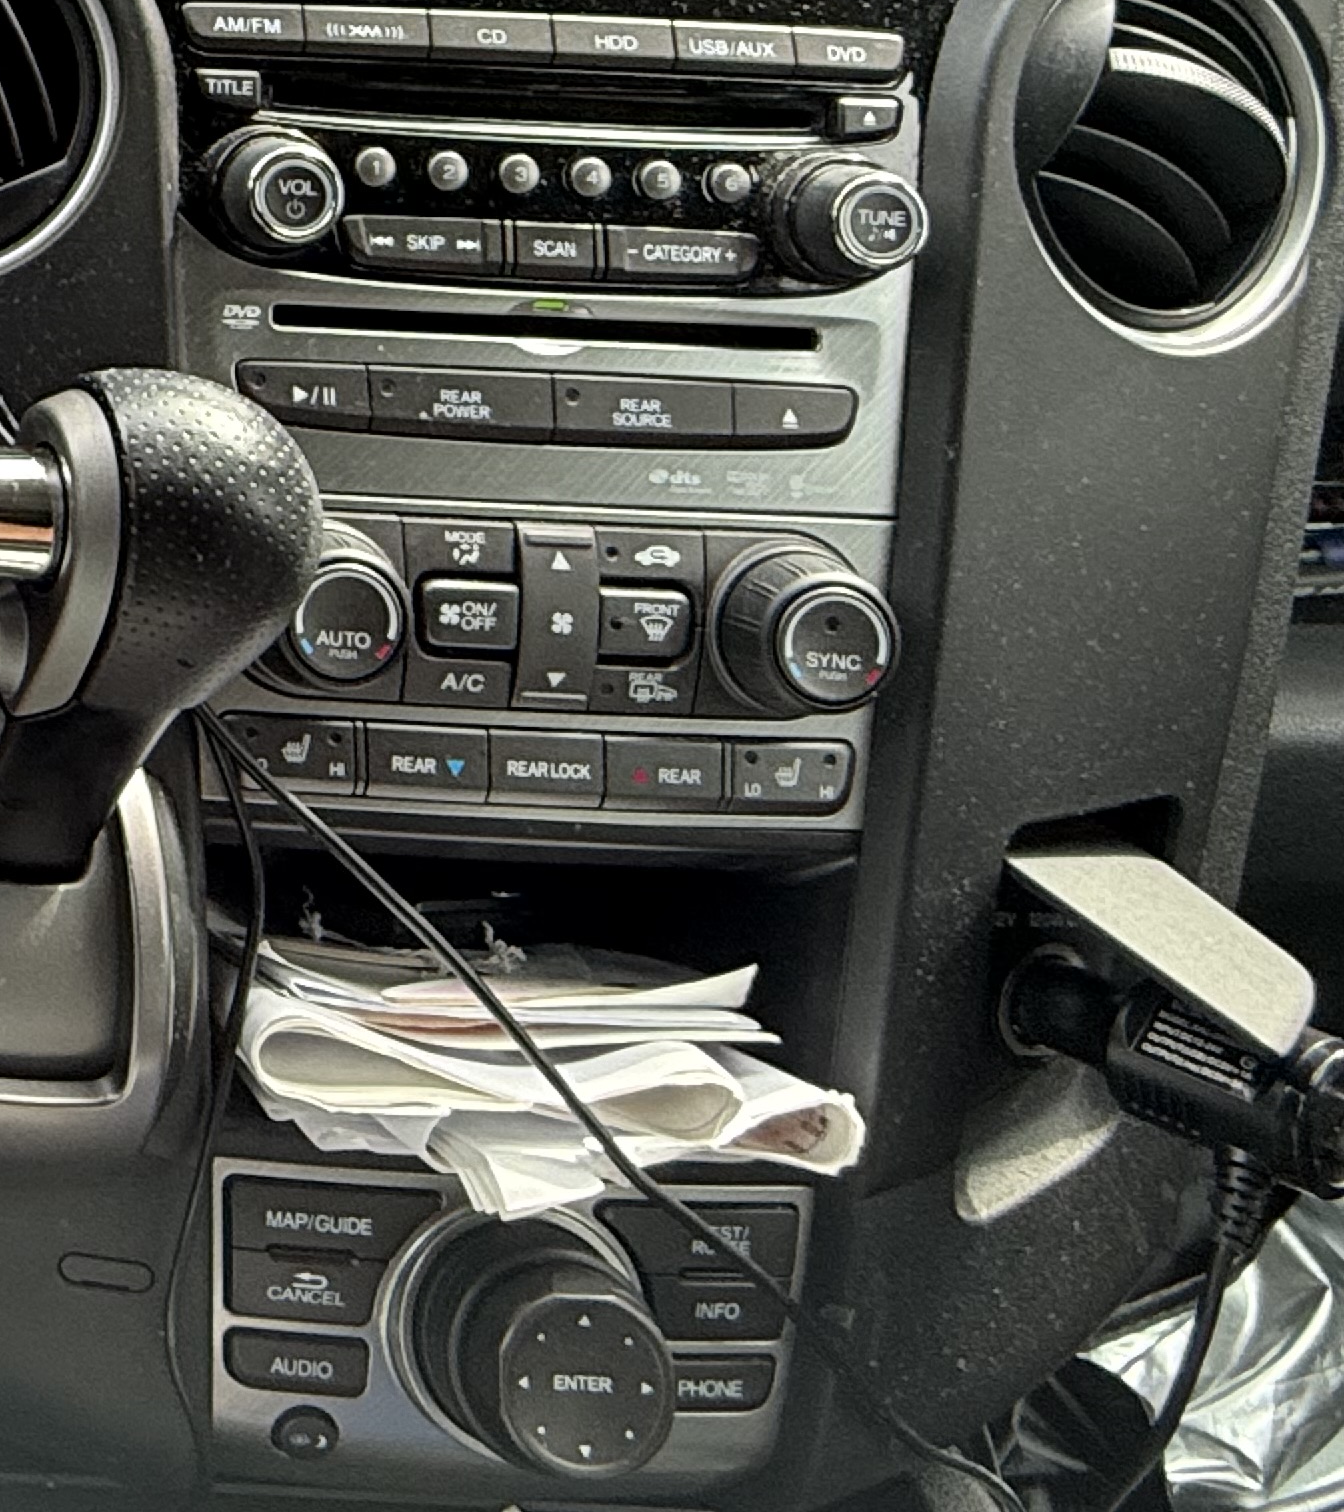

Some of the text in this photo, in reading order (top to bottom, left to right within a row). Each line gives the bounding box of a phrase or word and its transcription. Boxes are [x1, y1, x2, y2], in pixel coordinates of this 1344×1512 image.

[213, 16, 282, 35] AM/FM
[476, 28, 508, 45] CD
[594, 34, 639, 50] HDD
[689, 39, 776, 58] USB/AUX
[827, 45, 868, 63] DVD
[205, 78, 254, 96] TITLE
[372, 161, 382, 176] 1
[442, 164, 456, 180] 2
[515, 166, 528, 182] 3
[586, 169, 600, 185] 4
[278, 179, 318, 197] VOL
[656, 172, 668, 188] 5
[726, 175, 739, 191] 6
[859, 209, 907, 227] TUNE
[406, 234, 446, 251] SKIP
[533, 240, 577, 258] SCAN
[643, 244, 724, 265] CATEGORY
[440, 389, 482, 404] REAR
[433, 404, 491, 421] POWER
[620, 399, 661, 413] REAR
[612, 413, 672, 429] SOURCE
[445, 531, 486, 545] MODE
[461, 601, 497, 616] ON/
[634, 603, 680, 617] FRONT
[461, 615, 497, 631] OFF
[316, 630, 371, 650] AUTO
[805, 652, 862, 672] SYNC
[441, 673, 486, 692] A/C
[329, 762, 345, 777] HI
[391, 755, 436, 774] REAR
[507, 761, 592, 781] REAR LOCK
[658, 769, 701, 785] REAR
[744, 784, 761, 797] LO
[819, 786, 834, 799] HI
[265, 1211, 372, 1236] MAP/GUIDE
[267, 1285, 345, 1308] CANCEL
[695, 1303, 740, 1320] INFO
[271, 1357, 333, 1379] AUDIO
[553, 1375, 613, 1393] ENTER
[678, 1380, 744, 1399] PHONE
